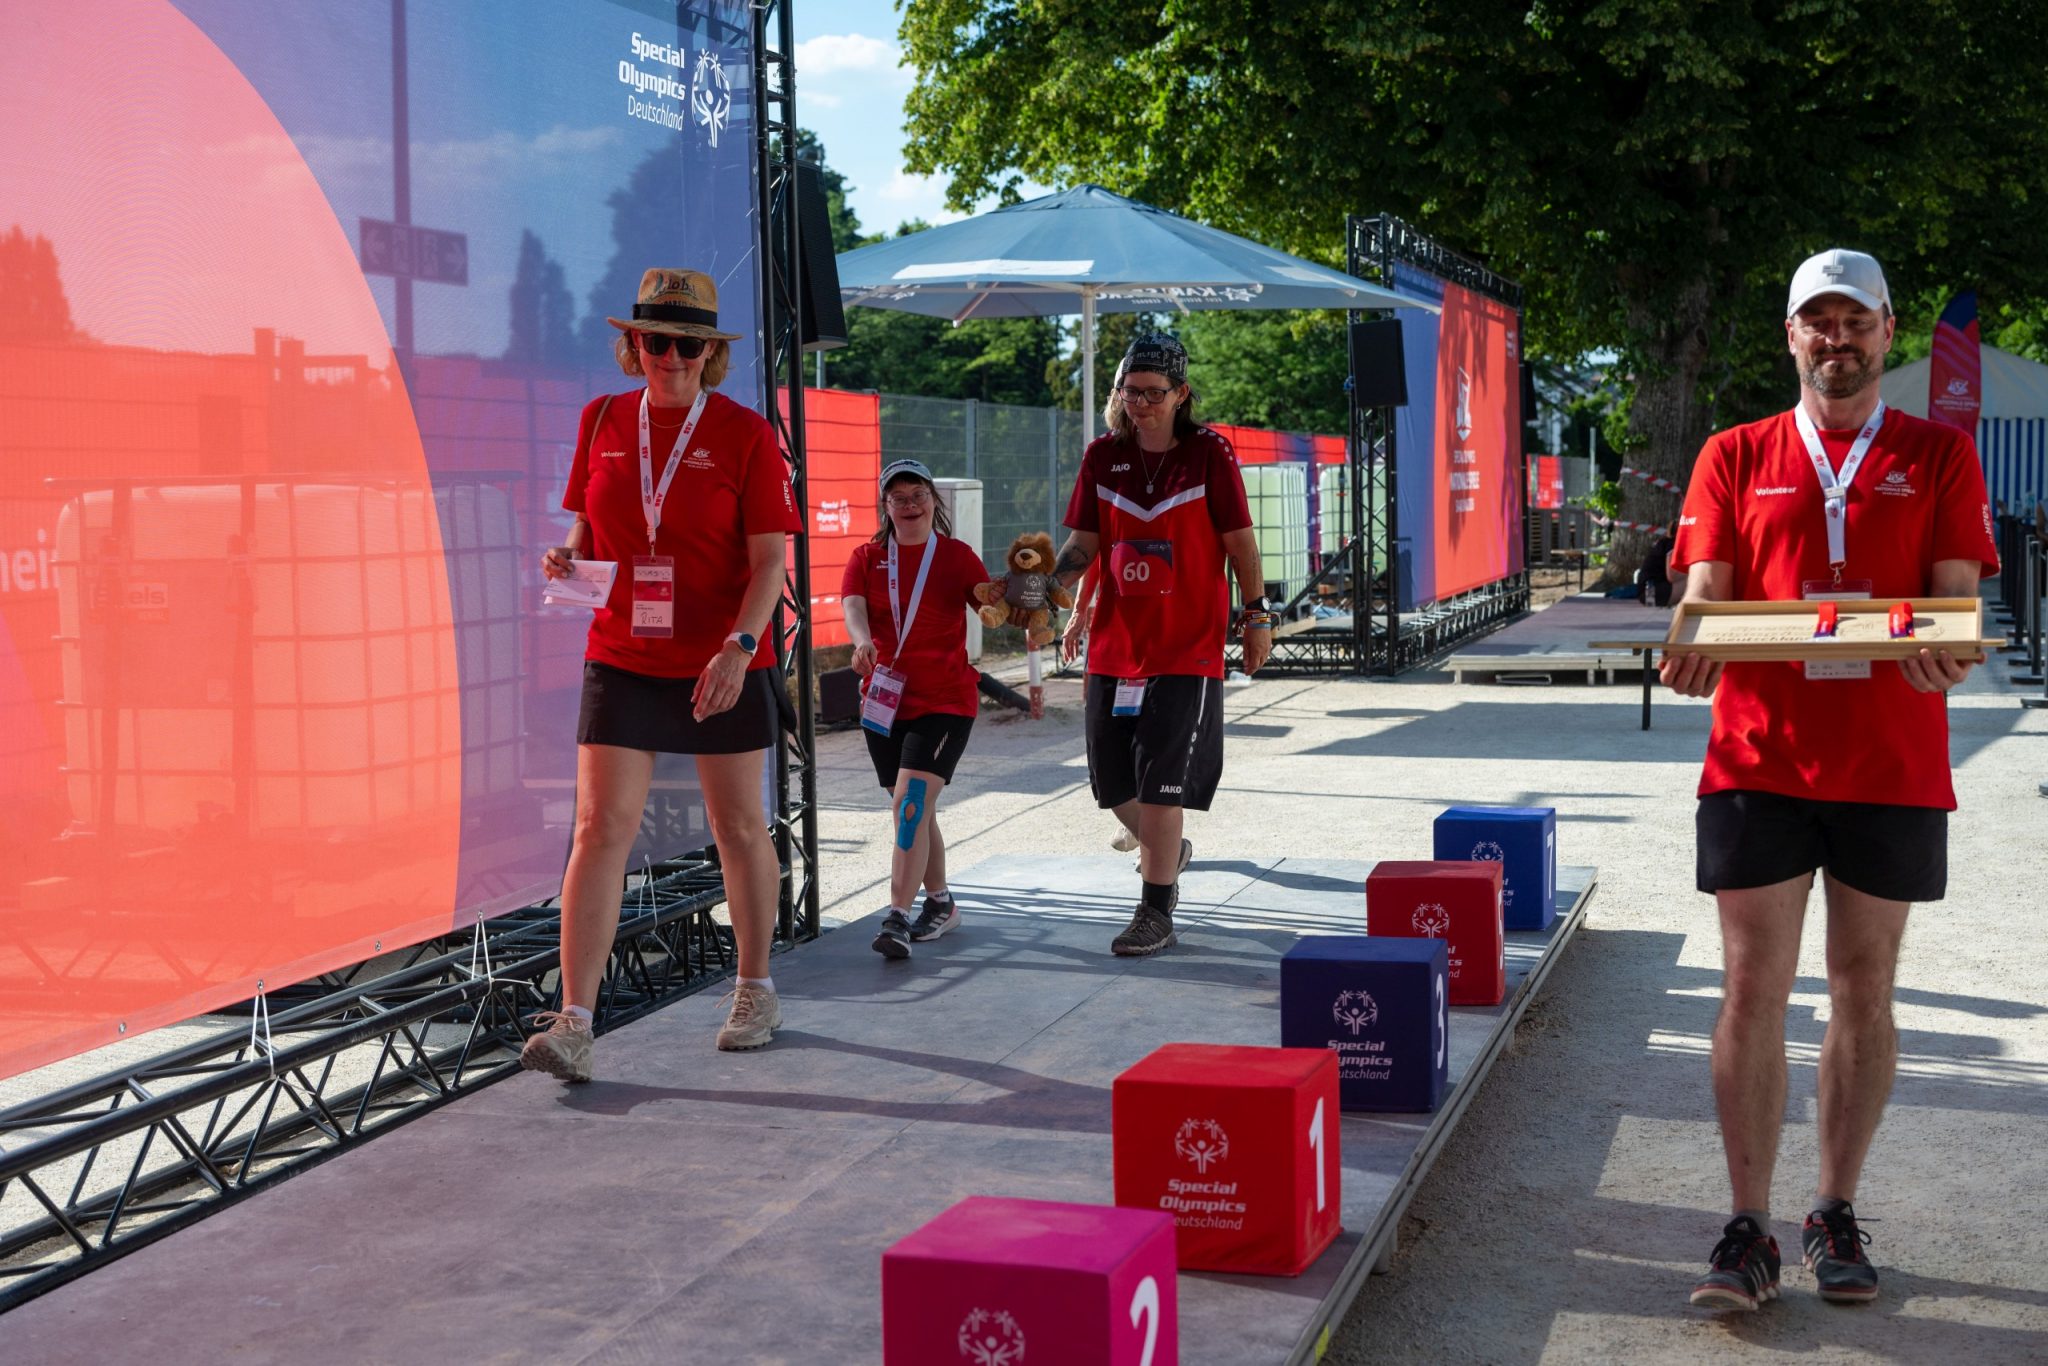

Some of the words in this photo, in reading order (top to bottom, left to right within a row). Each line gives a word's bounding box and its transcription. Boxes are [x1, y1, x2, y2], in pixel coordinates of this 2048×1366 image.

[631, 31, 685, 69] Special
[619, 60, 687, 100] Olympics
[627, 95, 684, 131] Deutschland
[1755, 486, 1797, 496] Volunteer
[1123, 561, 1150, 582] 60
[641, 612, 663, 625] RITA
[1160, 785, 1182, 794] JAKO
[1546, 830, 1554, 900] 7
[1435, 973, 1445, 1070] 3
[1327, 1039, 1386, 1052] Special
[1338, 1054, 1393, 1067] ympics
[1338, 1068, 1391, 1081] utschland
[1308, 1096, 1326, 1214] 1
[1167, 1179, 1238, 1196] Special
[1159, 1195, 1247, 1214] Olympics
[1174, 1214, 1244, 1231] eutschland
[1129, 1275, 1160, 1366] 2
